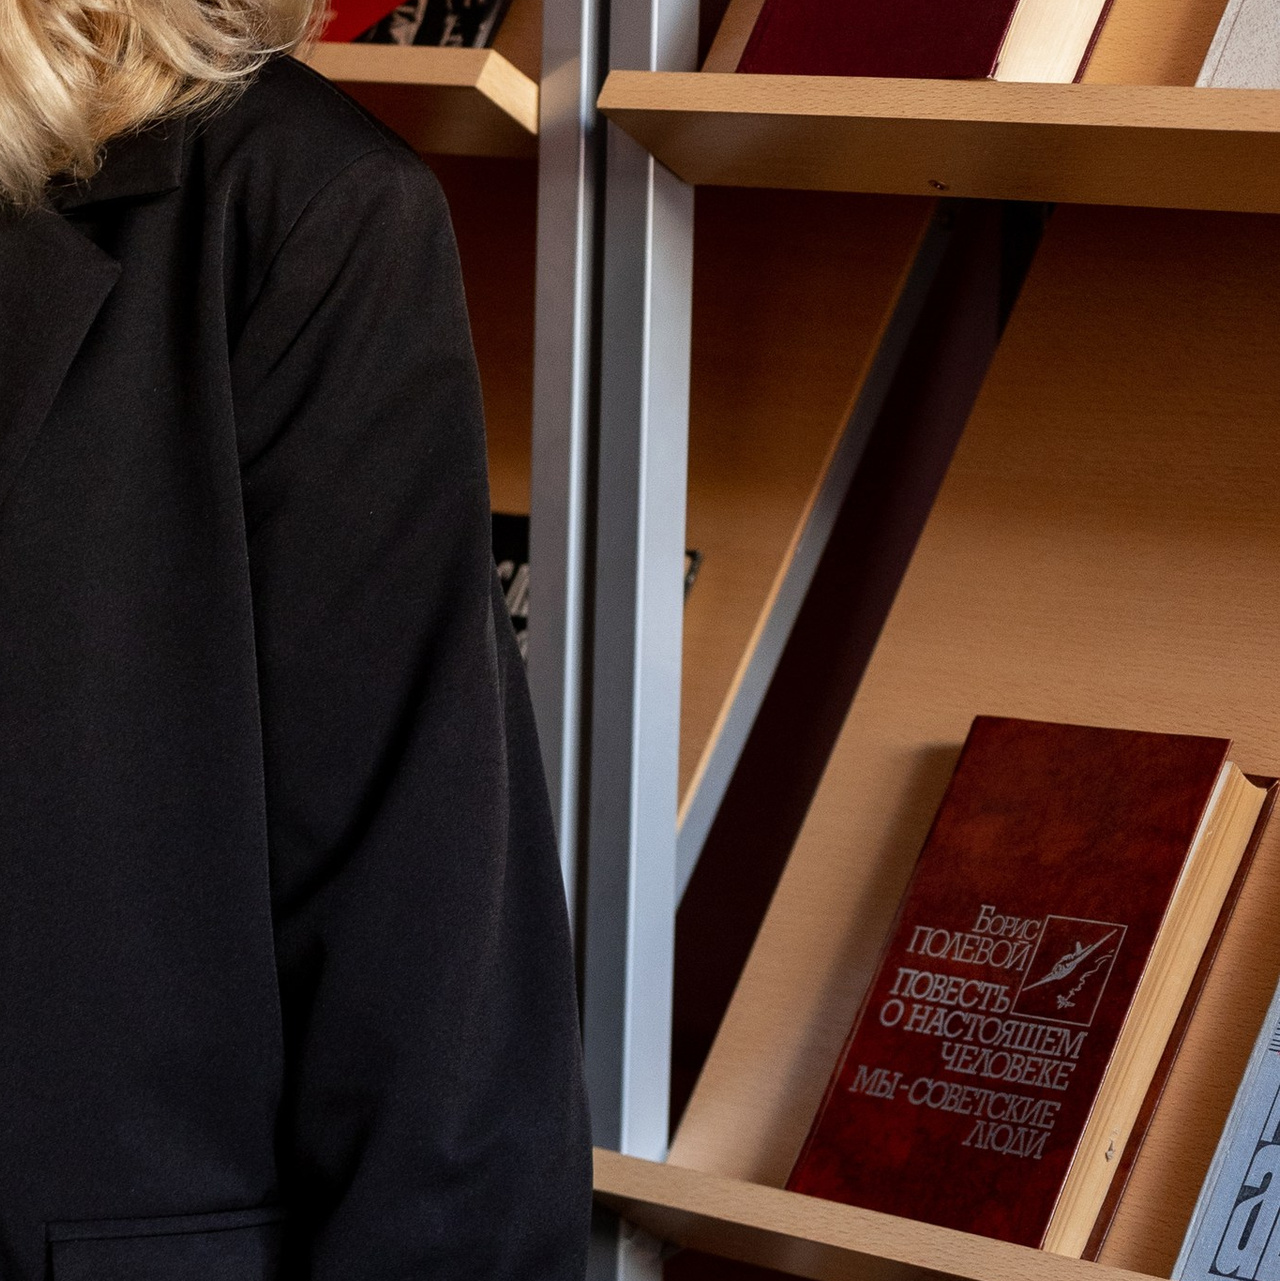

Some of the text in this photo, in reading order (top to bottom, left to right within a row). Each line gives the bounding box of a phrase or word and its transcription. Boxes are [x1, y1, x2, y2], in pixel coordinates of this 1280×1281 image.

[907, 925, 1034, 971] ПОЛЕВОЙ
[890, 968, 1011, 1013] ПОВЕСТЬ
[879, 998, 1088, 1059] О НАСТОЯЩЕМ
[941, 1041, 1076, 1091] ЧЕЛОВЕКЕ
[962, 1121, 1051, 1159] ЛЮДИ
